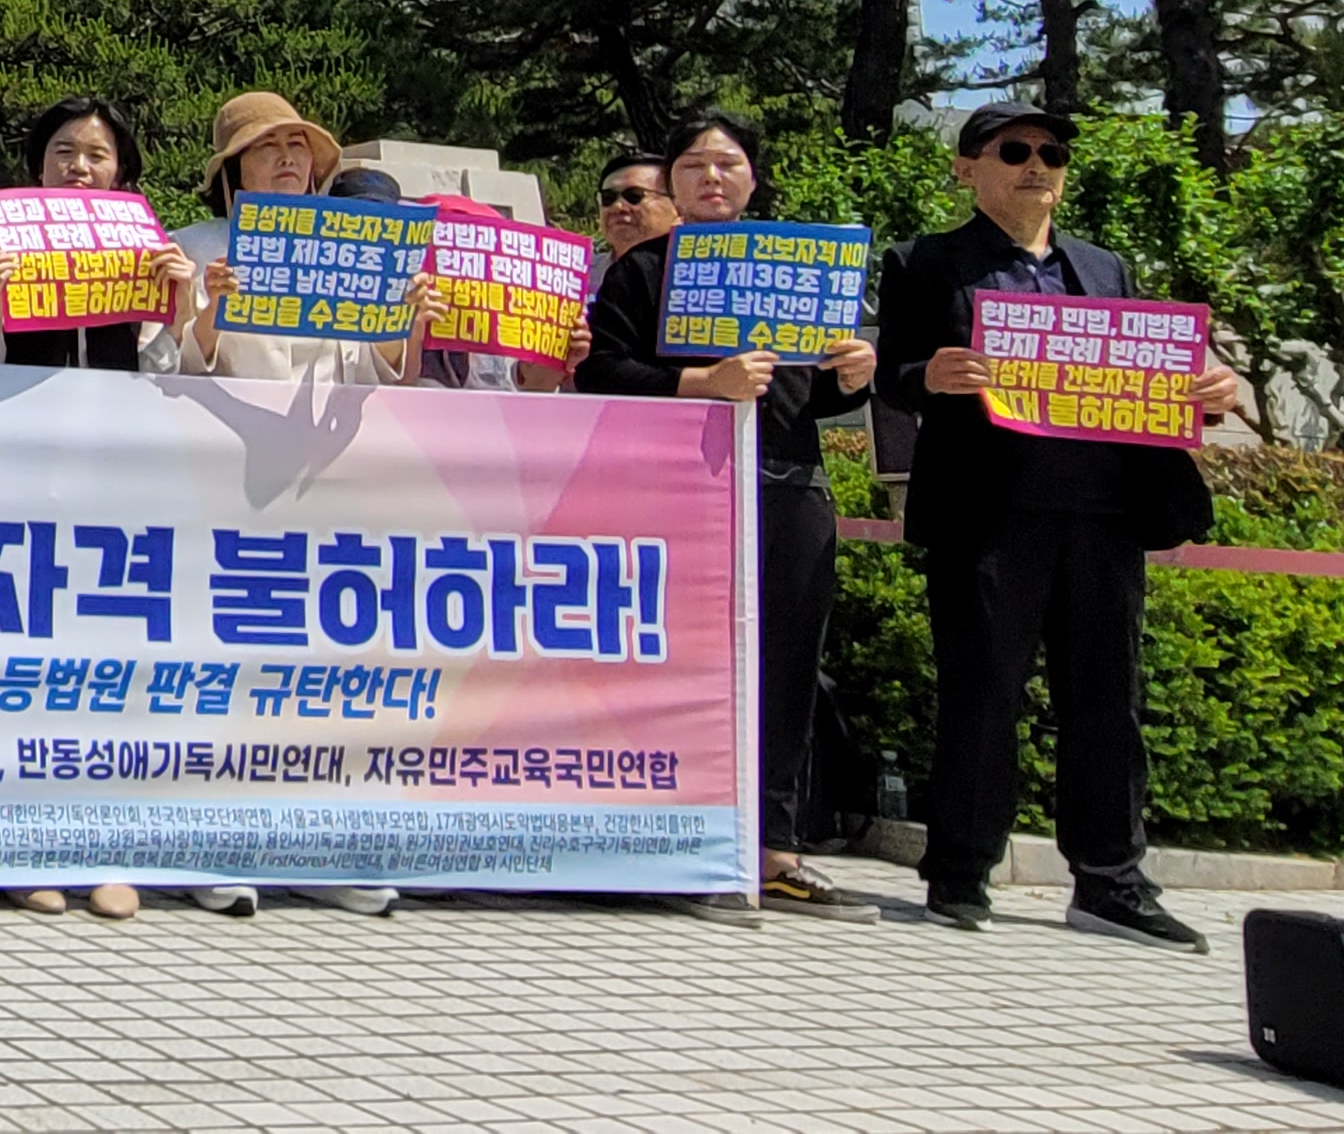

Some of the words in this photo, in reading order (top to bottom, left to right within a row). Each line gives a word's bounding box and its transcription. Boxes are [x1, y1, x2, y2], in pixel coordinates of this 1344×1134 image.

[236, 235, 286, 263] 헌법
[291, 239, 385, 271] 제36조
[500, 228, 540, 261] 민법,
[542, 237, 588, 274] 대법원,
[677, 234, 748, 259] 동성커플
[753, 234, 836, 267] 건보자격
[839, 243, 868, 268] NO!
[296, 268, 381, 300] 남녀간의
[435, 249, 486, 280] 헌재
[490, 254, 532, 287] 판례
[536, 259, 582, 299] 반하는
[673, 262, 720, 286] 헌법
[725, 262, 821, 293] 제36조
[828, 270, 861, 296] 1항
[6, 282, 57, 318] 절대
[64, 280, 169, 316] 불허하라!
[224, 294, 301, 327] 헌법을
[668, 289, 725, 313] 혼인은
[731, 290, 819, 322] 남녀간의
[823, 299, 859, 325] 결합
[665, 316, 740, 347] 헌법을
[981, 300, 1056, 331] 헌법과
[1062, 306, 1117, 336] 민법,
[1121, 311, 1202, 343] 대법원,
[984, 329, 1040, 359] 헌재
[1046, 334, 1103, 364] 판례
[1109, 340, 1192, 372] 반하는
[1047, 393, 1194, 439] 불허하라!
[209, 527, 667, 659] 불허하라!
[146, 659, 241, 715] 판결
[250, 664, 441, 720] 규탄한다!
[17, 737, 352, 786] 반동성애기독시민연대,
[364, 745, 679, 790] 자유민주교육국민연합
